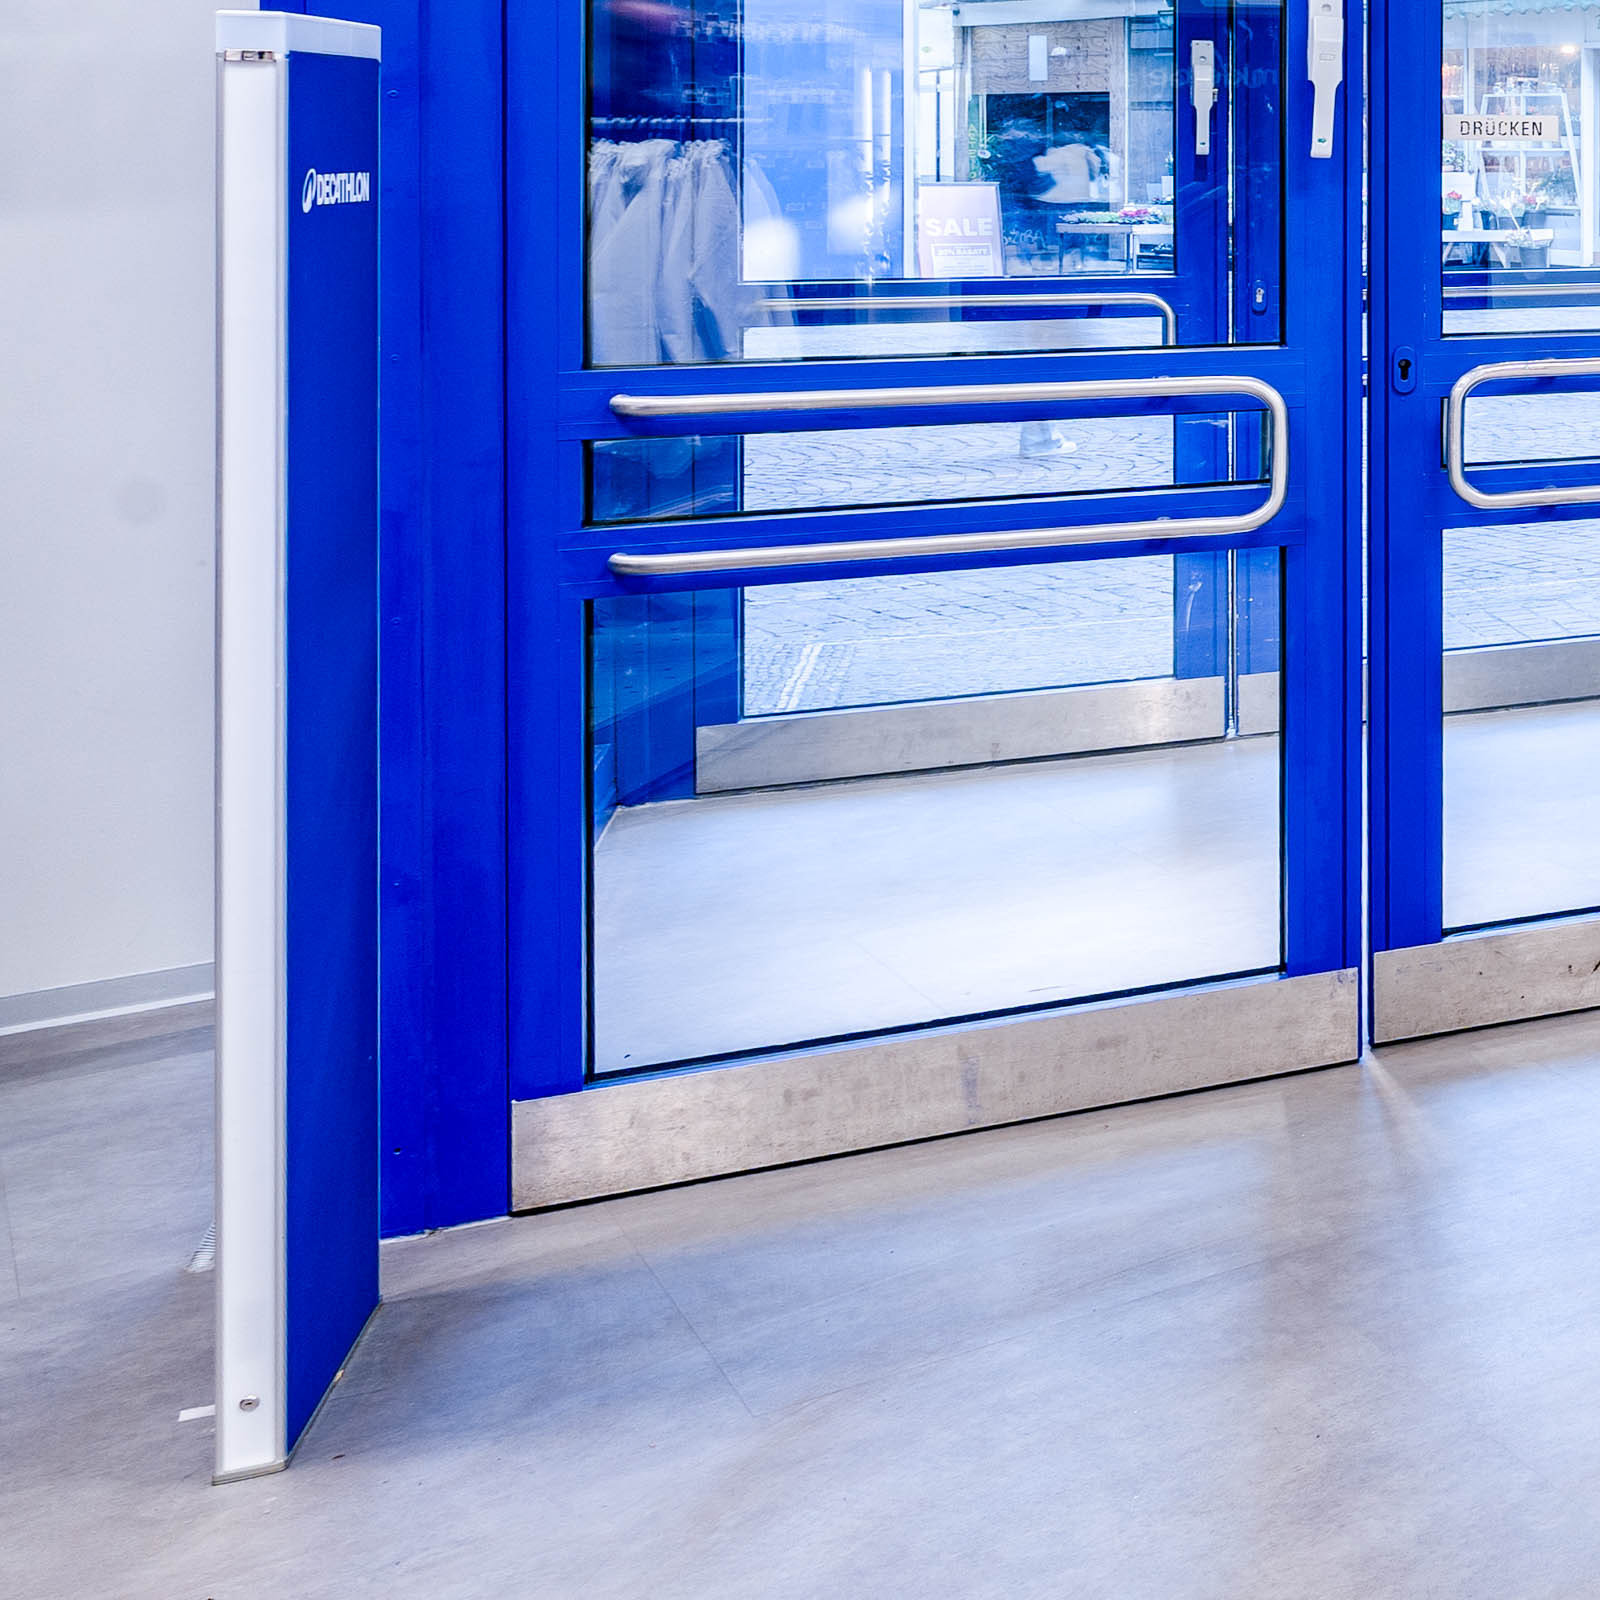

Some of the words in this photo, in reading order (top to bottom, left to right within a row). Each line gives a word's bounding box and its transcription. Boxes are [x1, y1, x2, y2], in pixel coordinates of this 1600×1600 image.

[1459, 118, 1543, 136] DRÜCKEN
[316, 171, 370, 206] DECATHLON
[925, 217, 994, 237] SALE
